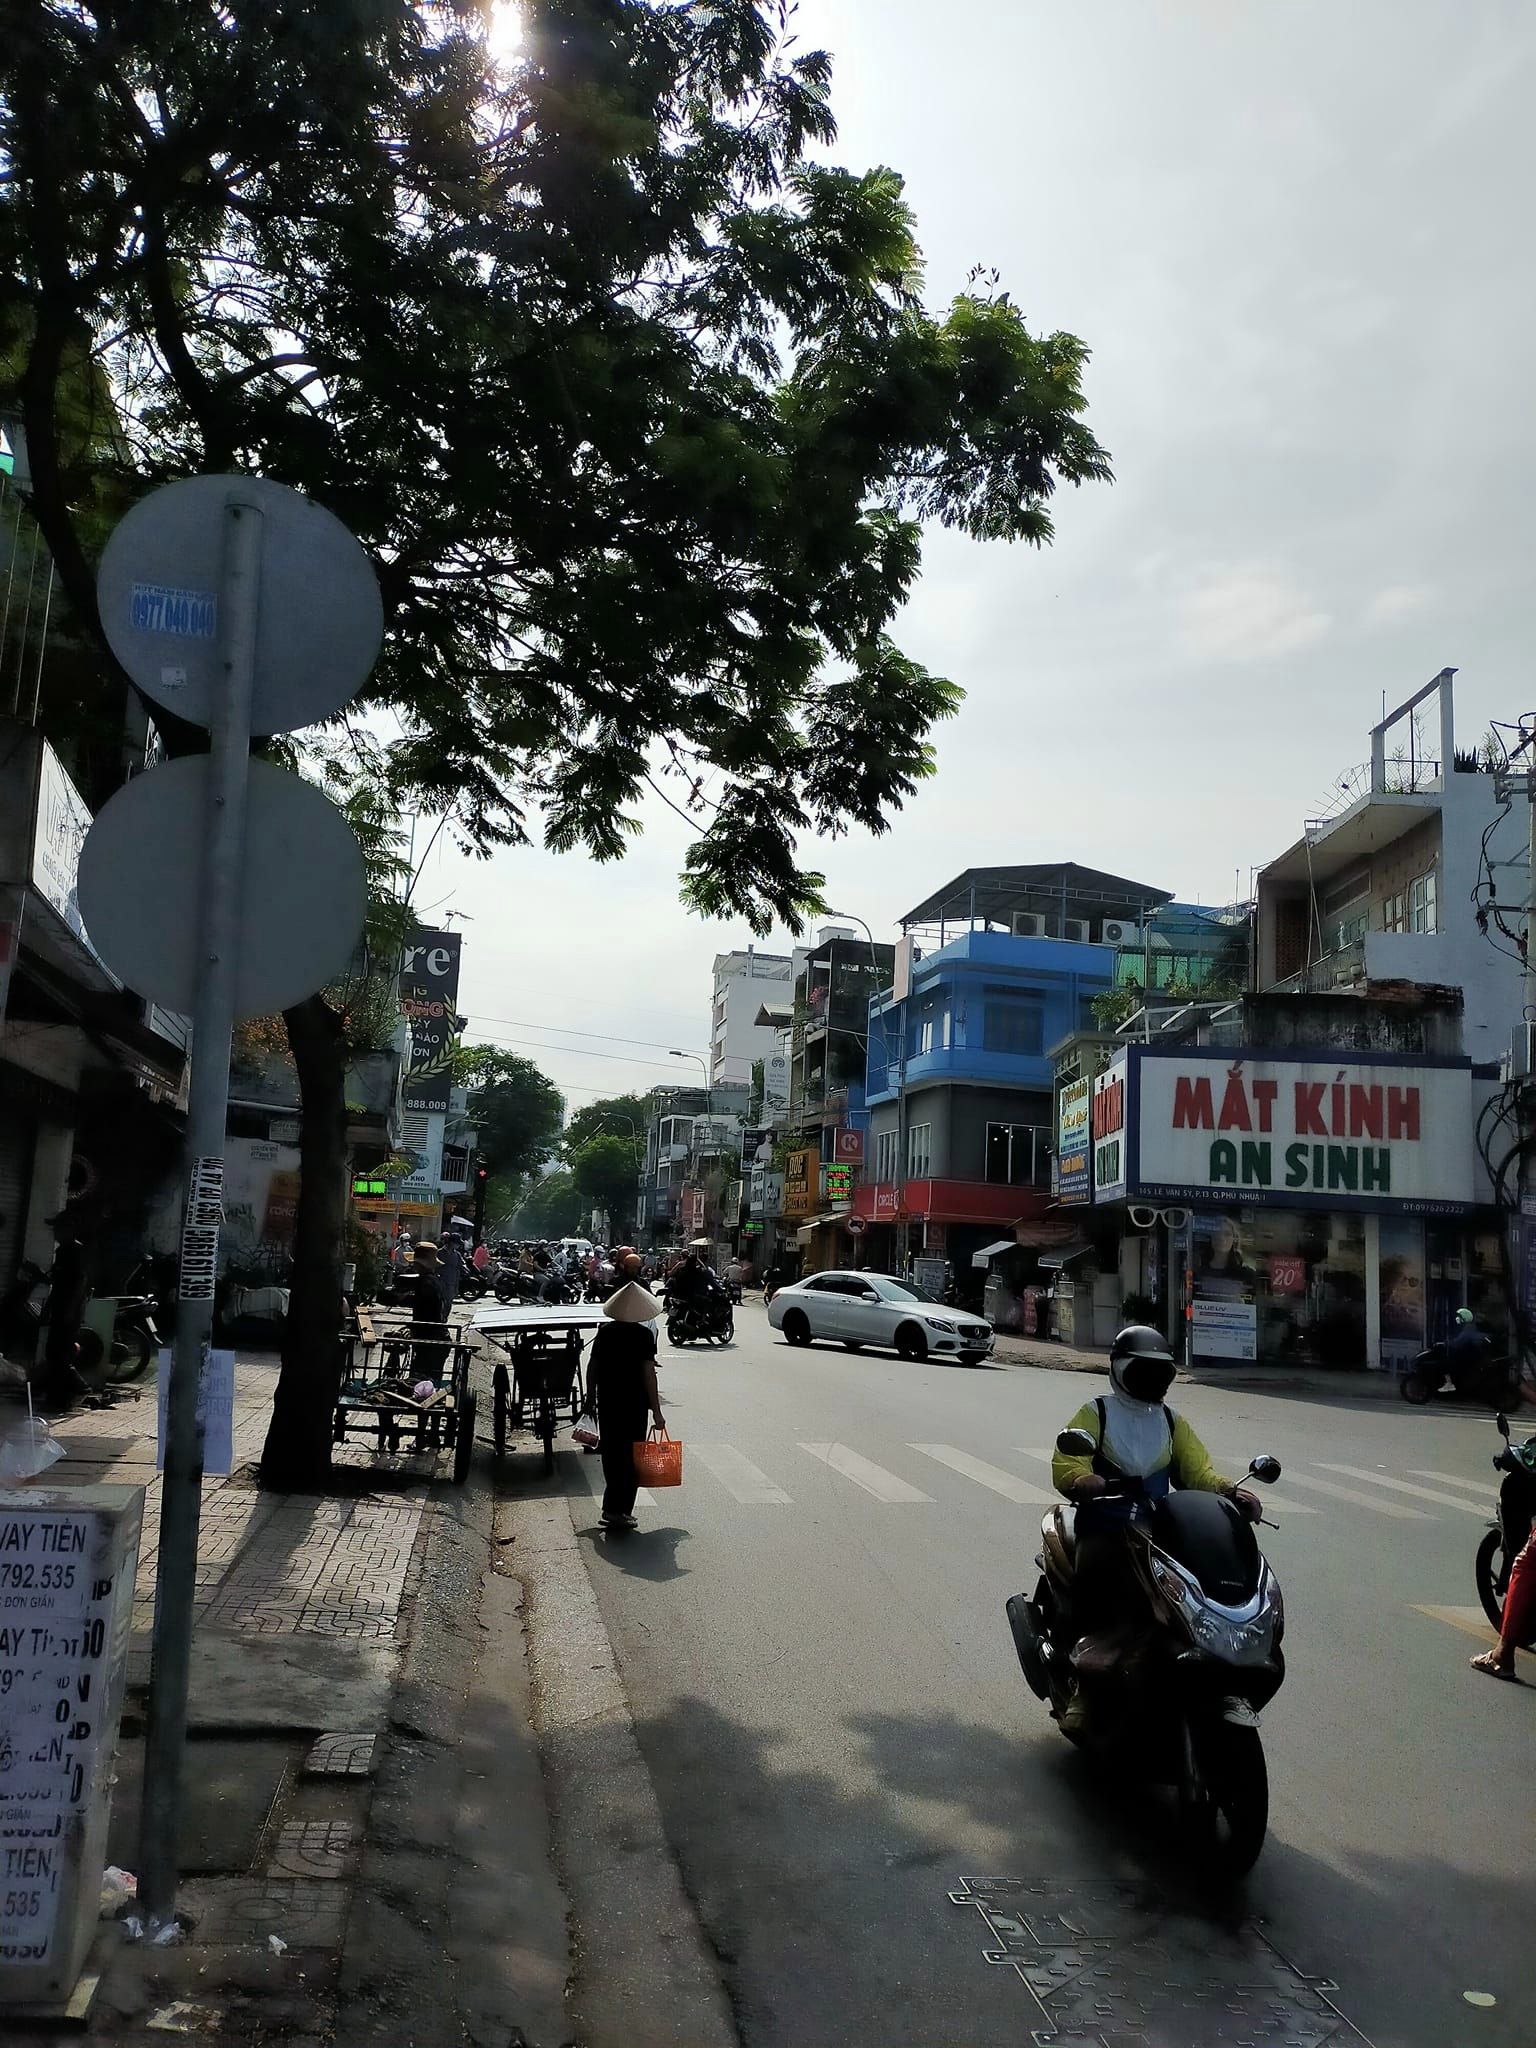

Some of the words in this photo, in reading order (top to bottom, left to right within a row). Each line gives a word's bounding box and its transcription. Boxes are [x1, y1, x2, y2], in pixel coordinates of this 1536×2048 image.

[1172, 1060, 1278, 1133] MẮT
[1294, 1070, 1420, 1140] KÍNH
[1209, 1139, 1271, 1186] AN
[1285, 1142, 1390, 1192] SINH
